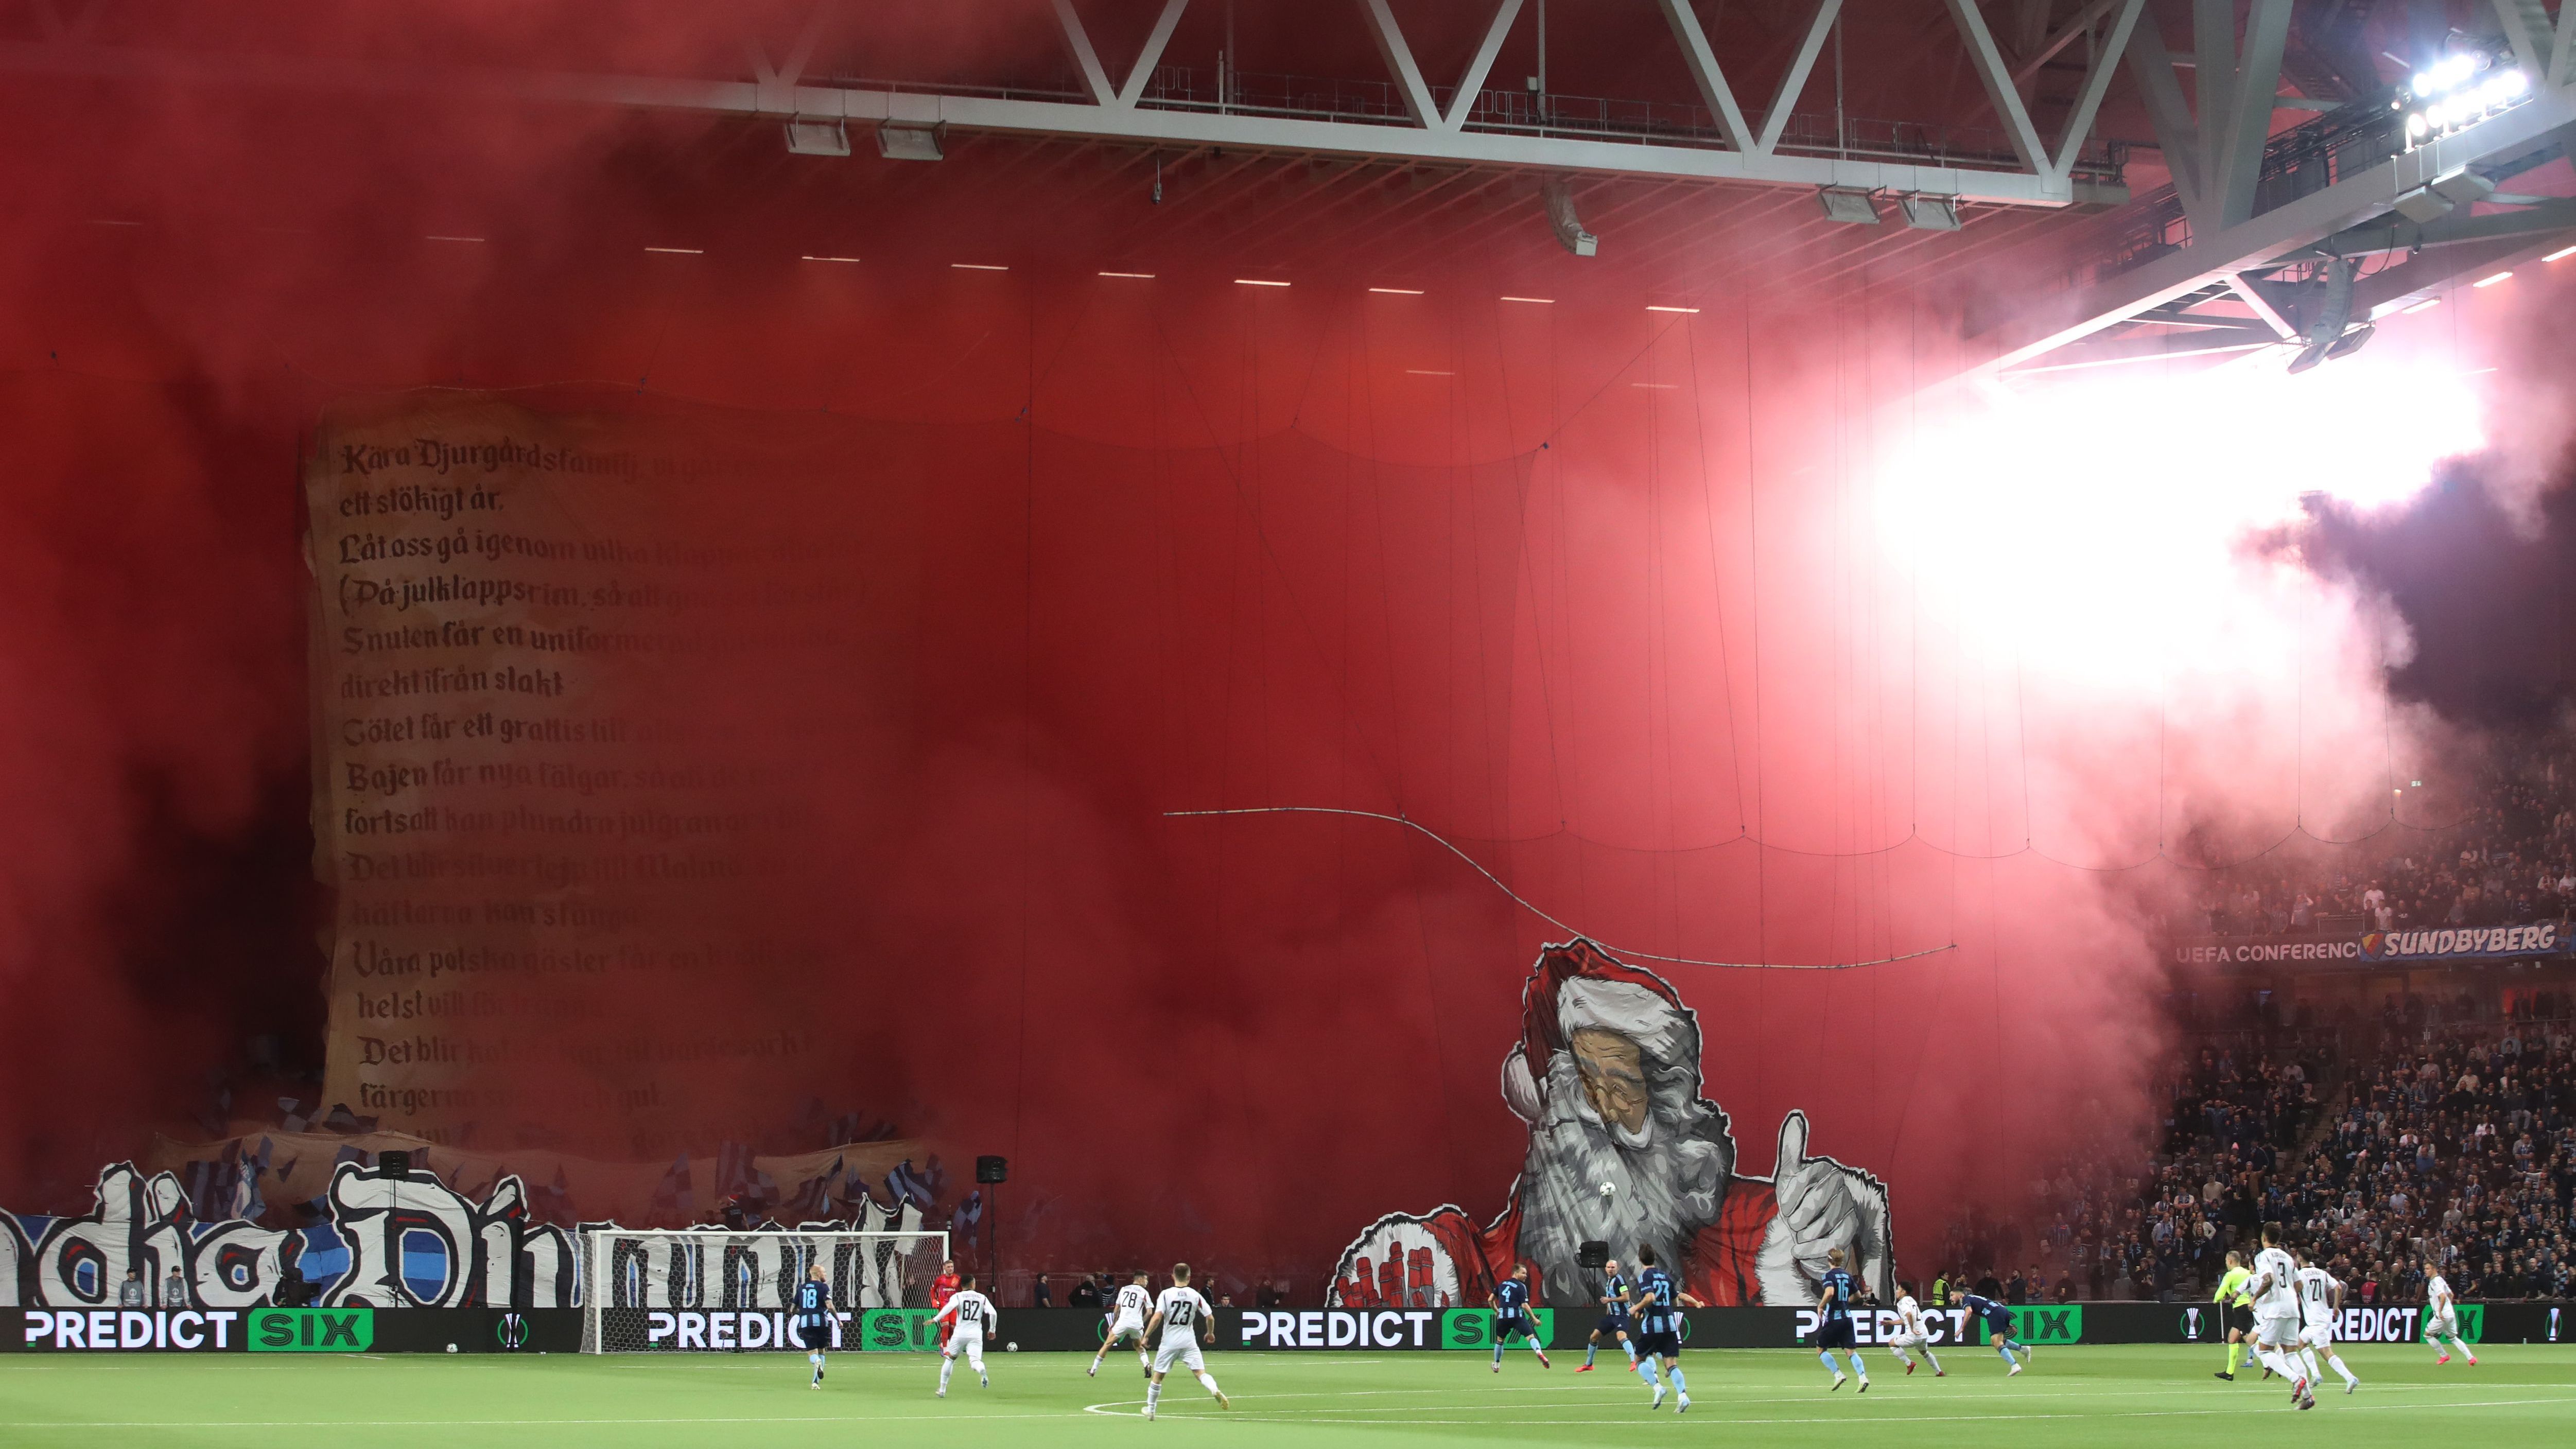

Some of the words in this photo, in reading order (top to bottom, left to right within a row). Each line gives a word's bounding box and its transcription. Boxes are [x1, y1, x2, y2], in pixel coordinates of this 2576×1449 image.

[344, 443, 410, 474] Kära
[340, 493, 370, 516] ett
[377, 485, 464, 520] stökigt
[339, 531, 386, 564] Låt
[393, 540, 433, 558] oss
[437, 527, 468, 563] gå
[476, 530, 575, 561] igenom
[342, 626, 437, 654] Snuten
[443, 621, 485, 646] får
[493, 626, 523, 645] en
[341, 669, 419, 699] direkt
[426, 665, 488, 695] ifrån
[495, 667, 565, 696] slakt
[342, 717, 414, 748] Götet
[421, 713, 457, 740] får
[464, 713, 493, 736] ett
[500, 720, 585, 745] grattis
[346, 762, 428, 795] Bajen
[434, 759, 471, 786] får
[479, 765, 531, 791] nya
[346, 807, 438, 835] fortsatt
[2176, 946, 2231, 964] UEFA
[2235, 941, 2361, 962] CONFERENC
[2384, 924, 2556, 956] SUNDBYBERG
[353, 941, 421, 977] Våra
[358, 991, 423, 1019] helst
[358, 1035, 413, 1065] Det
[417, 1036, 459, 1062] blir
[1837, 1279, 1849, 1301] 16
[2277, 1262, 2287, 1288] 3
[802, 1288, 817, 1308] 18
[1122, 1291, 1138, 1308] 28
[1502, 1286, 1511, 1302] 4
[1652, 1280, 1669, 1306] 23
[2309, 1279, 2322, 1302] 21
[963, 1300, 980, 1321] 82
[1169, 1301, 1192, 1325] 23
[2329, 1307, 2417, 1341] REDICT
[25, 1311, 237, 1348] PREDICT
[260, 1314, 359, 1347] SIX
[1242, 1312, 1432, 1347] PREDICT
[1796, 1309, 1965, 1343] PEDCT
